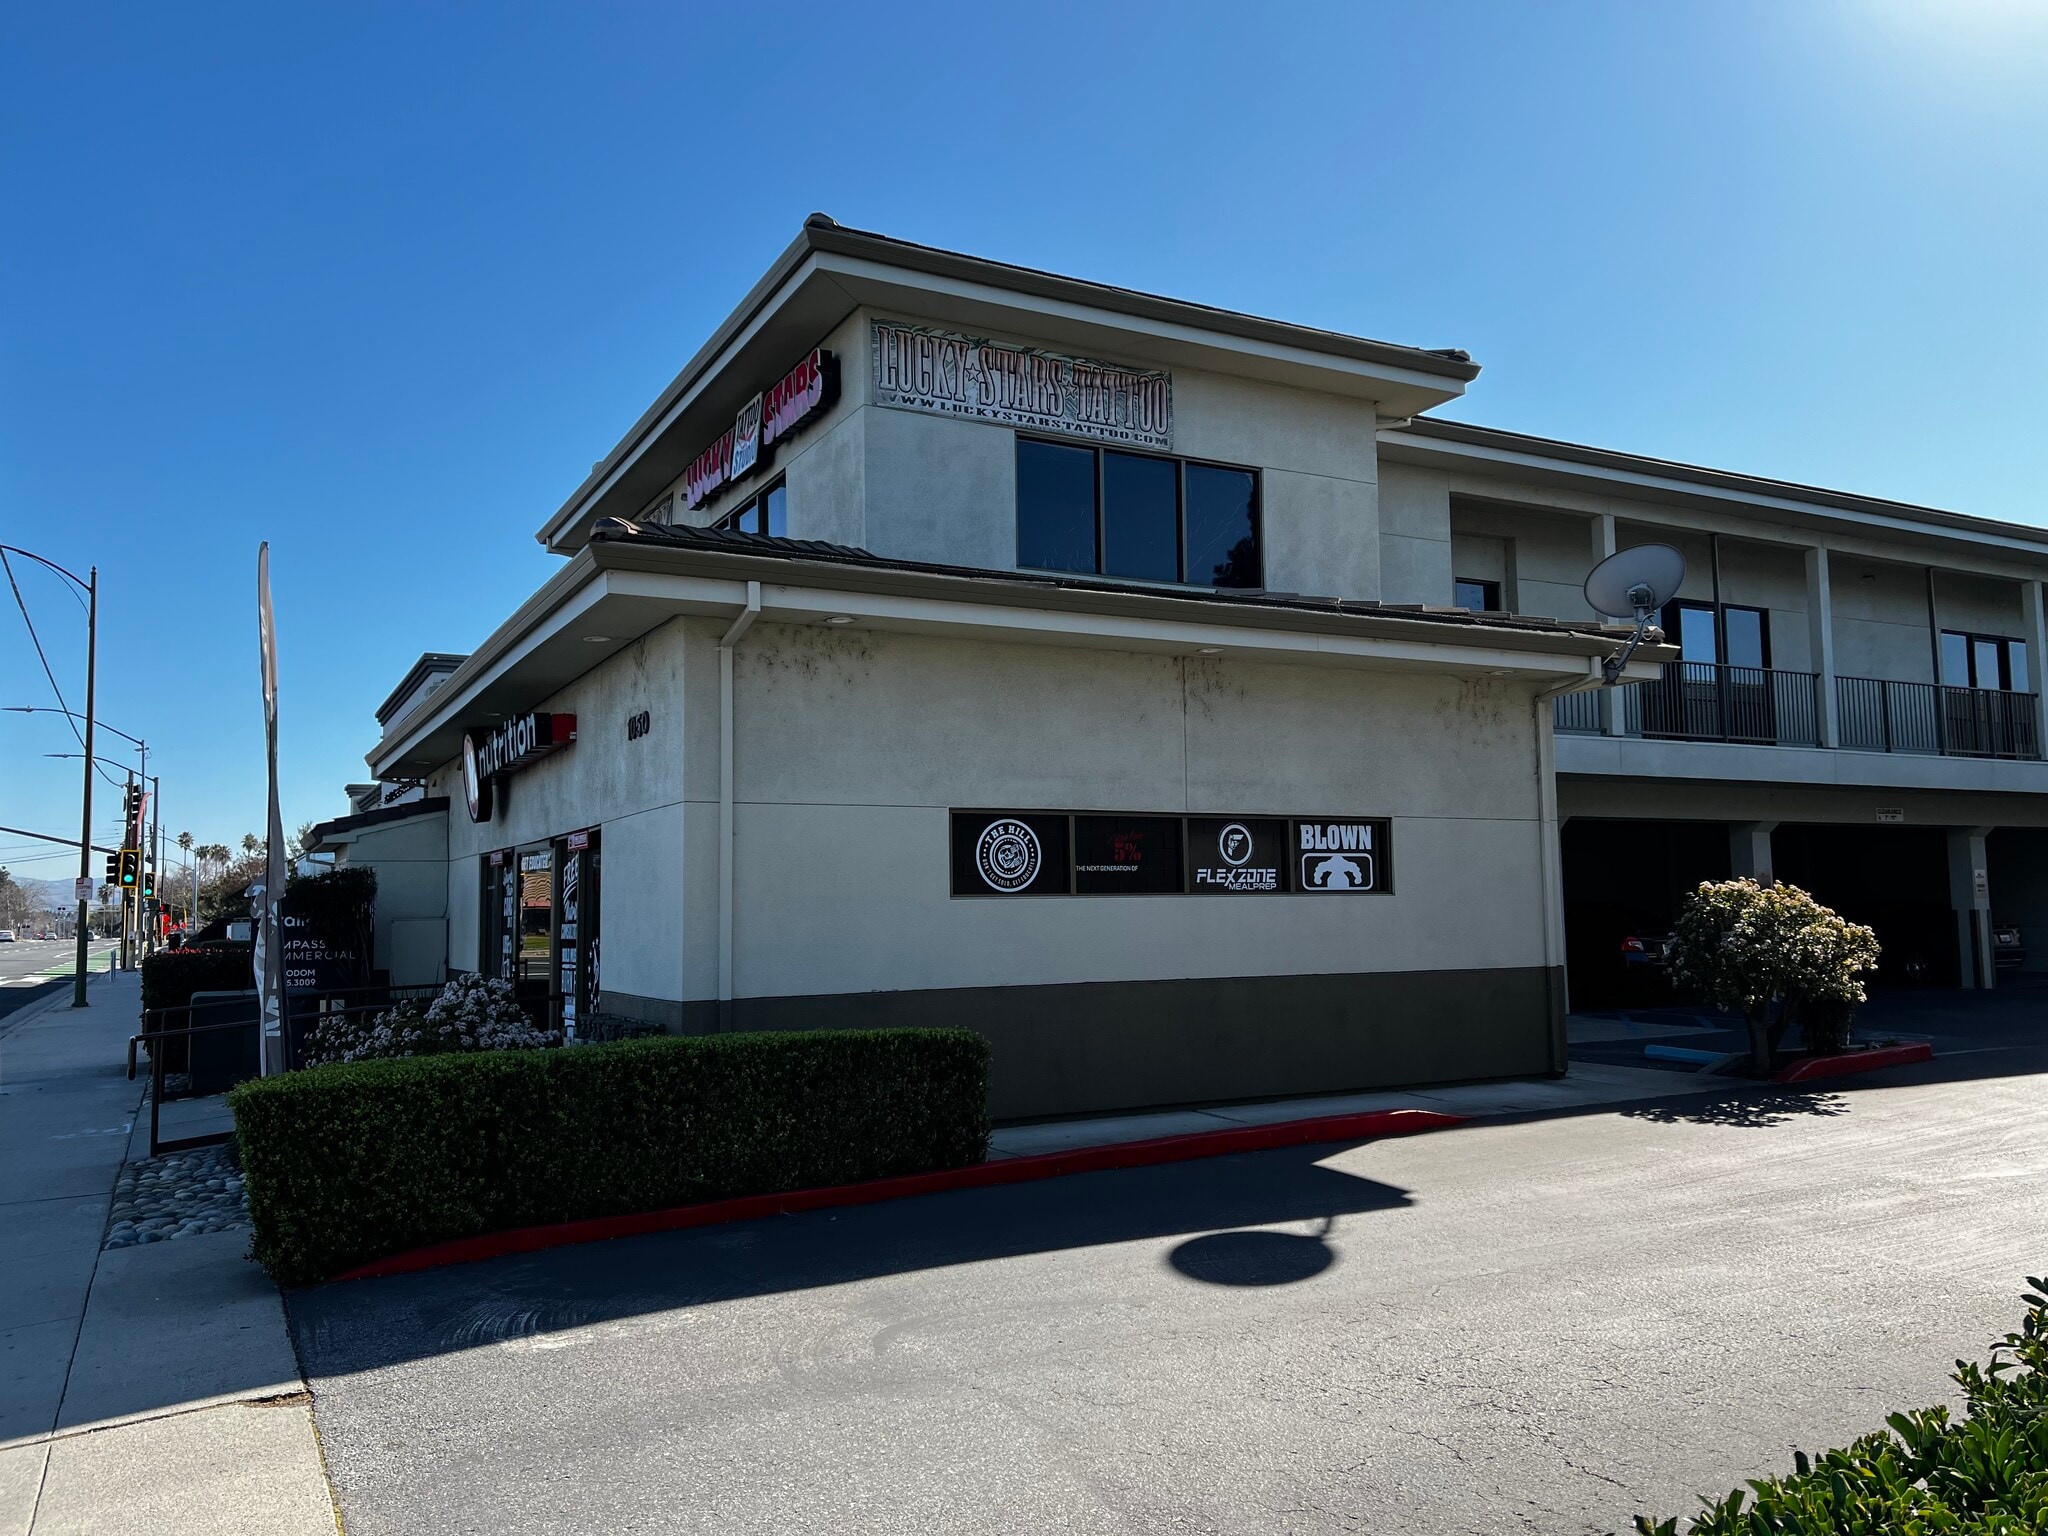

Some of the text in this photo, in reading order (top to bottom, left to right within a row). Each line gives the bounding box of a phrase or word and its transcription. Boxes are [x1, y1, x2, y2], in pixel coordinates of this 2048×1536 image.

[877, 326, 1169, 435] LUCKY STARS TATTOO
[686, 348, 823, 511] LUCKY STARS
[737, 397, 760, 441] TATTOO
[479, 712, 536, 780] nutrition
[985, 825, 1031, 844] THE HILL
[1300, 824, 1372, 850] BLOWN
[1229, 882, 1277, 891] MEALPREP
[286, 969, 316, 978] ODOM
[286, 978, 316, 987] 5.3009
